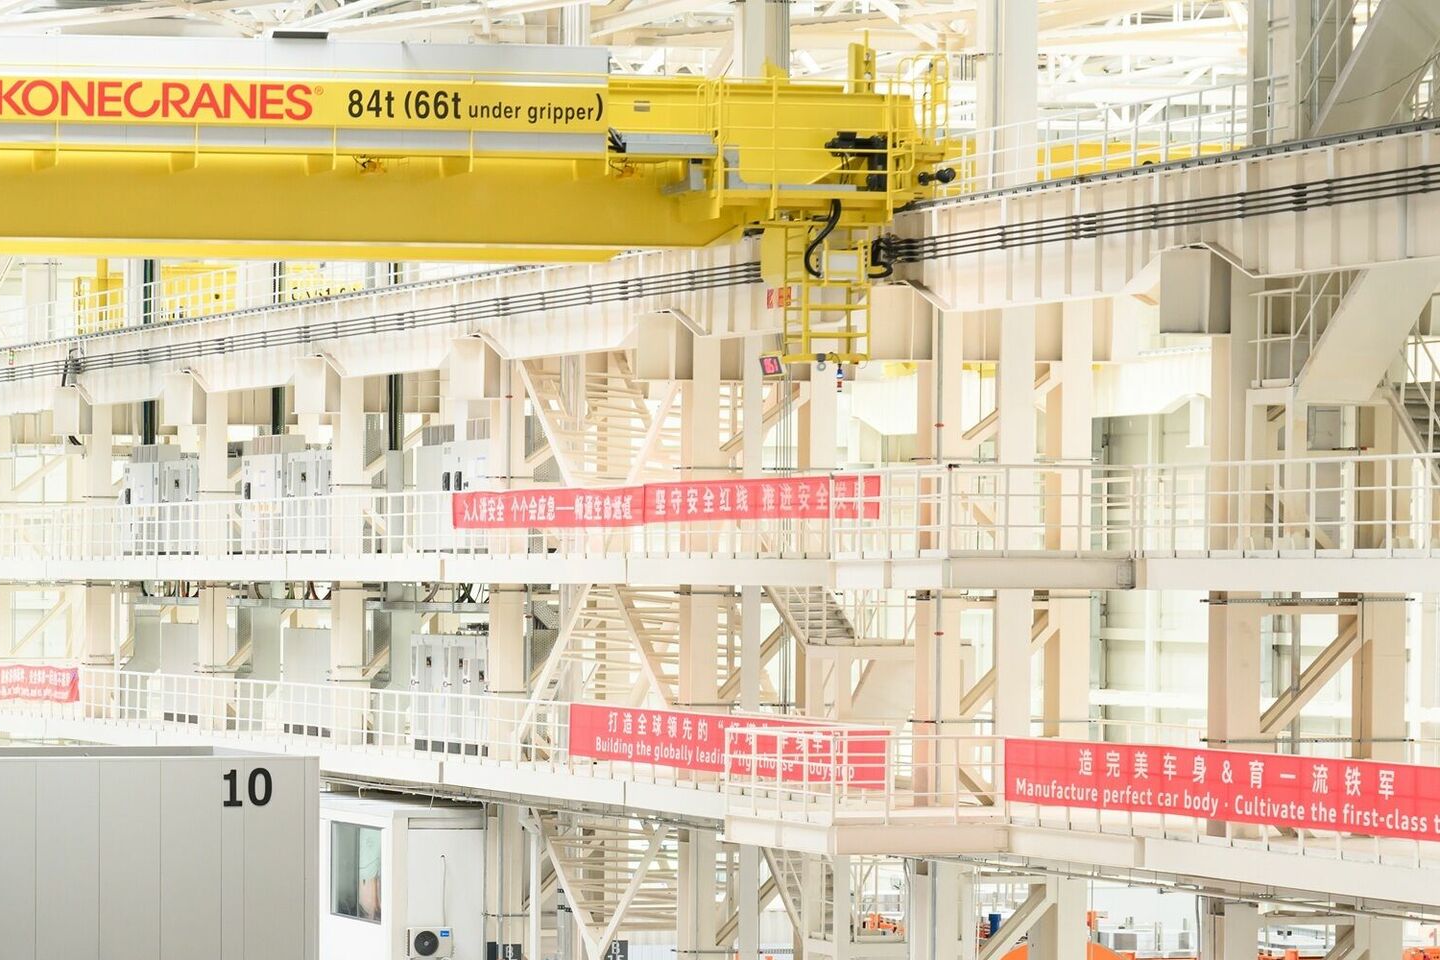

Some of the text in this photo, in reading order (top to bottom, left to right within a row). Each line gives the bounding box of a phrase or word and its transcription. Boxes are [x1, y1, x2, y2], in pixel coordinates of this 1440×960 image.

[348, 89, 395, 119] 84t
[404, 90, 461, 121] (66t
[469, 103, 521, 120] under
[528, 93, 604, 124] gripper)
[654, 483, 749, 516] 坚守安全红线
[596, 736, 633, 759] Building
[636, 740, 652, 756] the
[654, 742, 693, 766] globally
[695, 747, 731, 770] leadin
[223, 767, 273, 807] 10
[1016, 777, 1098, 803] Manufacture
[1103, 785, 1153, 808] perfect
[1157, 792, 1179, 807] car
[1183, 789, 1219, 818] body
[1235, 796, 1305, 821] Cultivate
[1310, 802, 1337, 823] the
[1342, 808, 1428, 834] first-class
[611, 942, 621, 955] B
